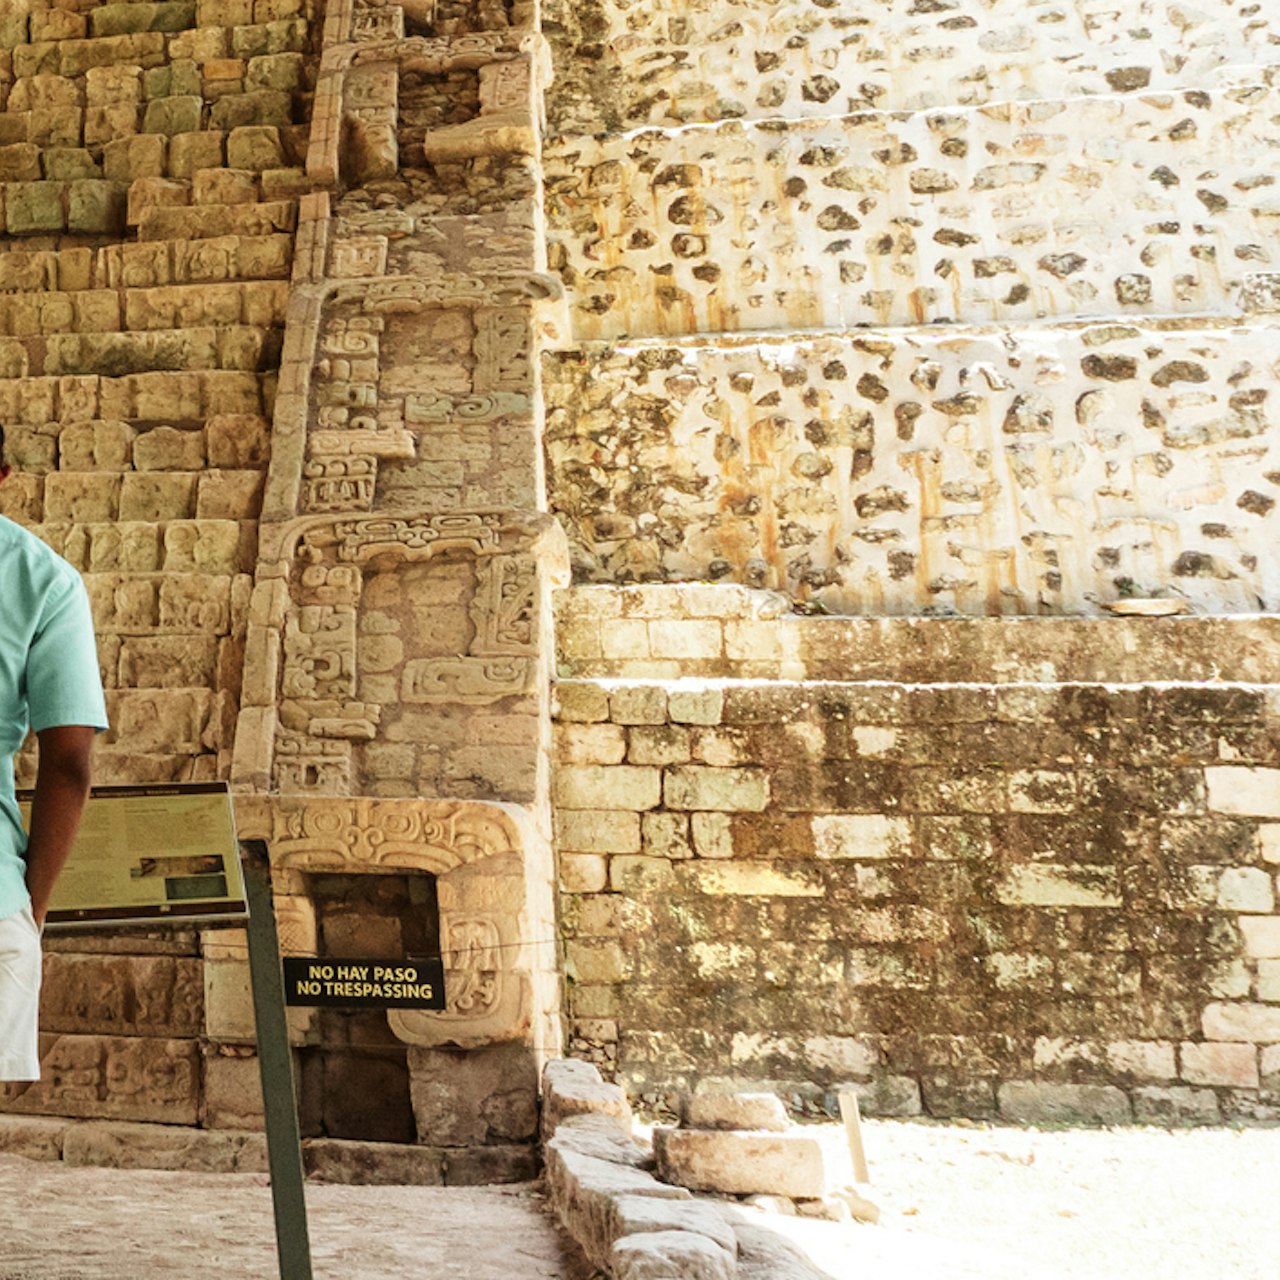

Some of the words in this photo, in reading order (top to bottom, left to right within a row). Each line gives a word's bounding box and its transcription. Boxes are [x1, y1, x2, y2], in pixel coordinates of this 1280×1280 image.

[309, 966, 334, 980] NO
[338, 966, 369, 981] HAY
[374, 967, 417, 982] PASO
[297, 981, 321, 995] NO
[323, 982, 433, 999] TRESPASSING
